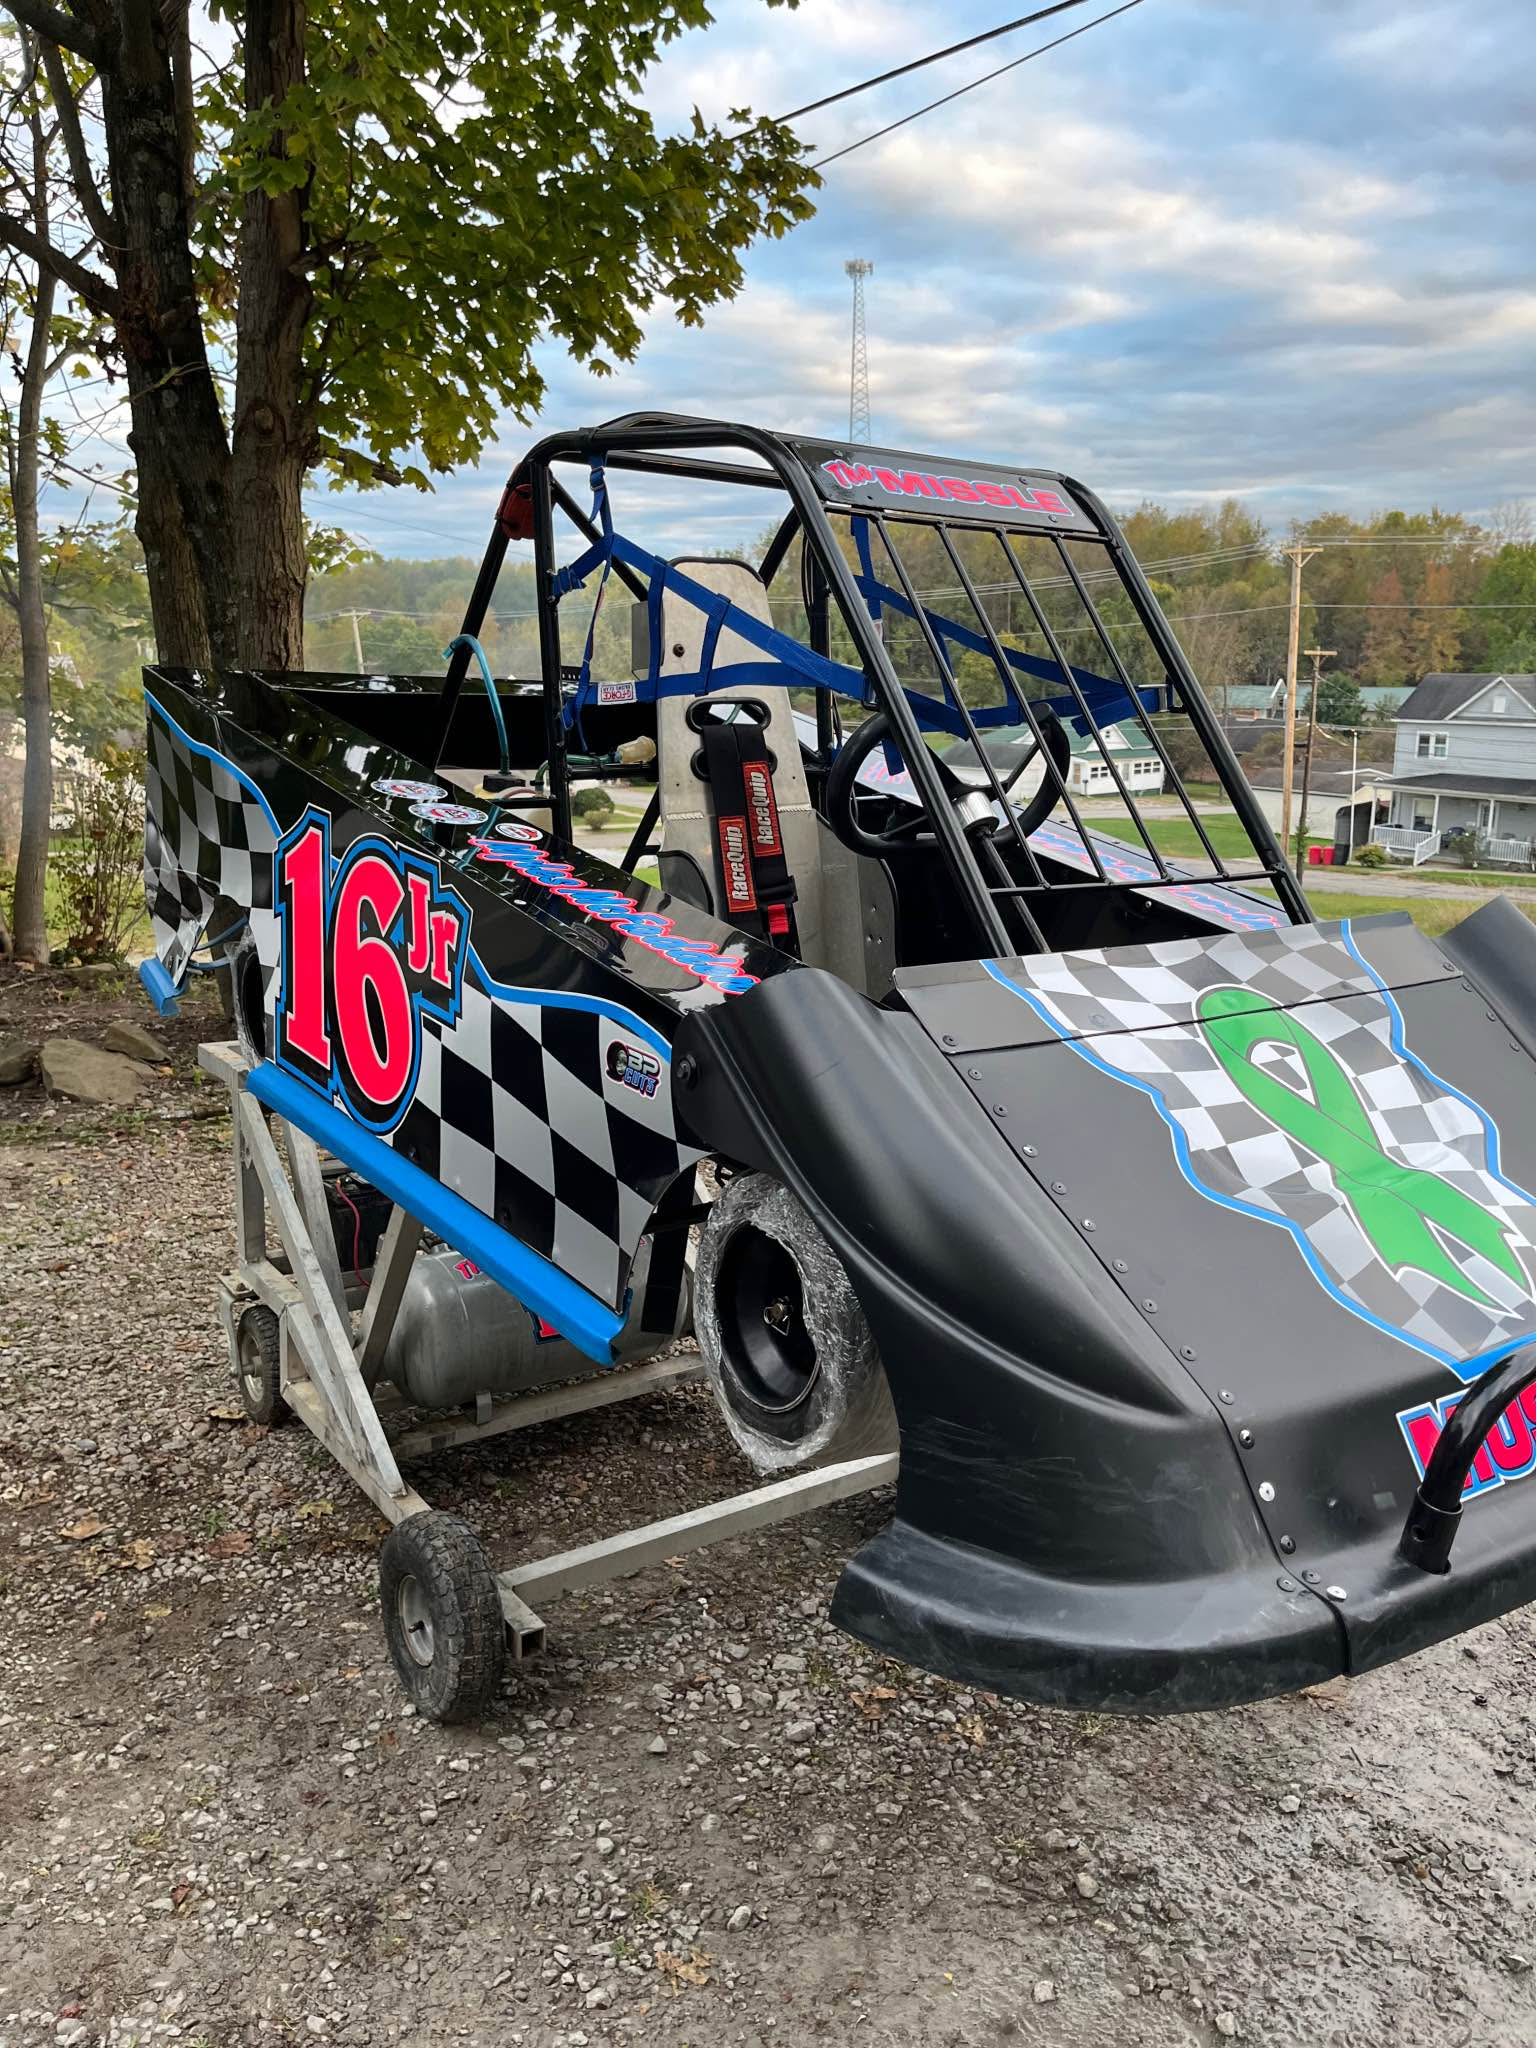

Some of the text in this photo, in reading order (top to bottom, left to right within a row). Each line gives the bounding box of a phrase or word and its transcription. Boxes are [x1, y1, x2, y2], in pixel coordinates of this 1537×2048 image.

[869, 466, 1074, 516] MISSLE
[751, 771, 774, 845] RaceQuip
[727, 826, 749, 901] RaceQuip
[283, 826, 459, 1106] 16 Jr
[624, 1067, 656, 1094] CUTS
[627, 1048, 660, 1075] BP
